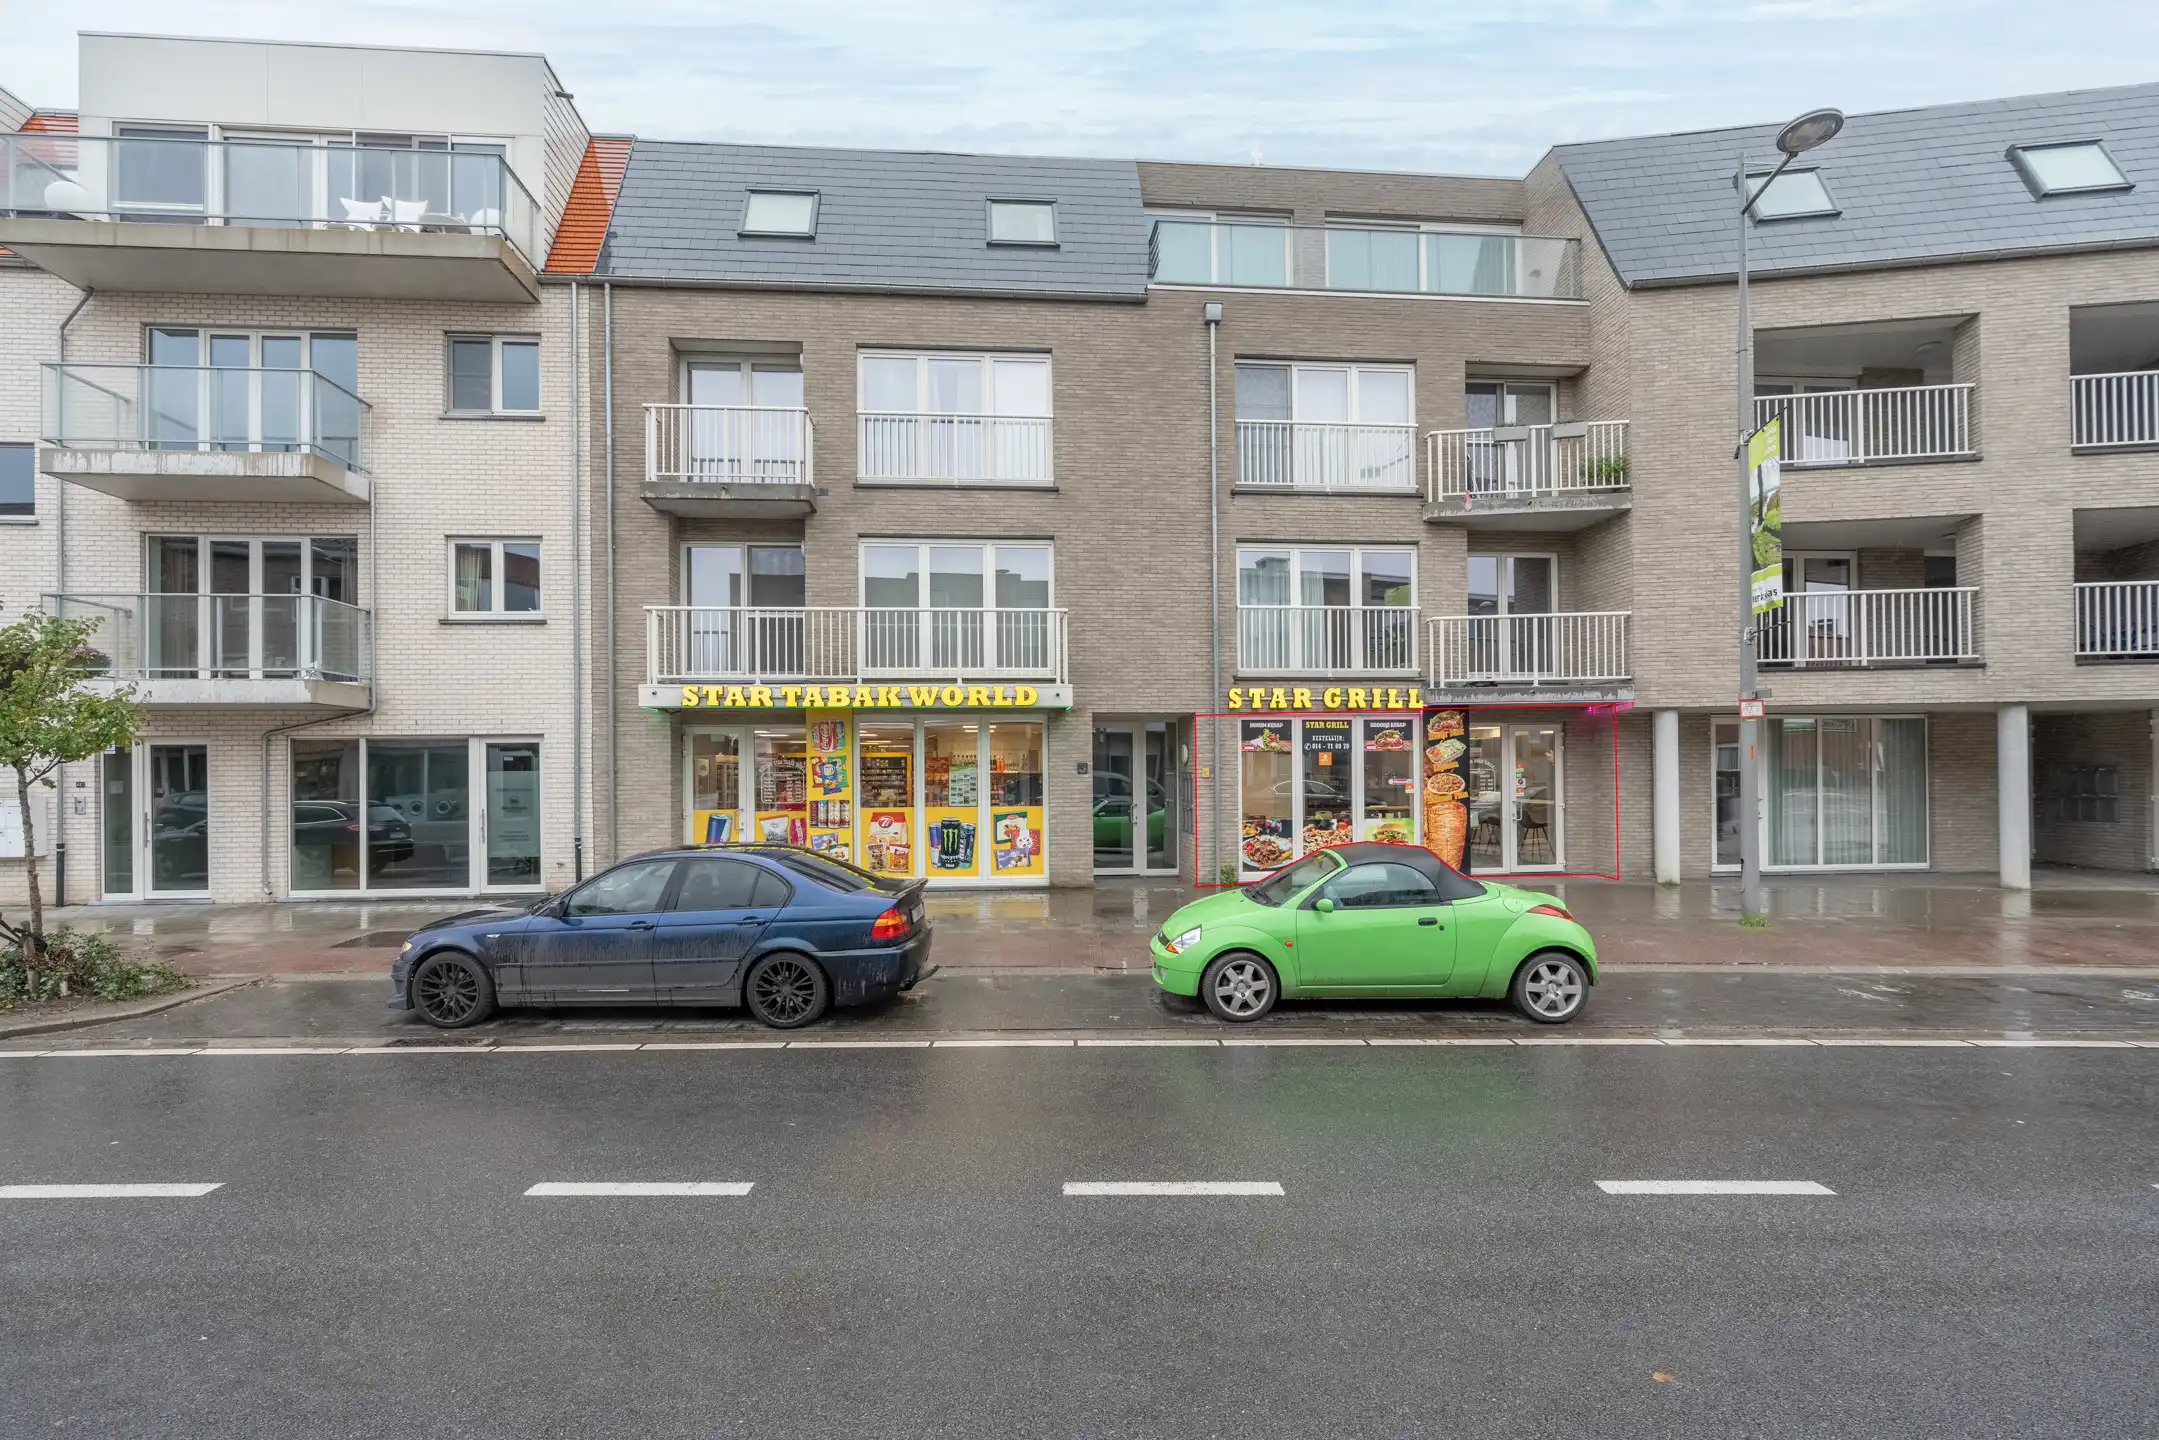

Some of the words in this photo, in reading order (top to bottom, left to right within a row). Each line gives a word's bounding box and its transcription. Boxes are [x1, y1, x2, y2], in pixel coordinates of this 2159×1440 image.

[681, 685, 774, 707] STAR
[781, 685, 902, 707] TABAK
[907, 685, 1038, 707] WORLD
[1228, 687, 1313, 709] STAR
[1323, 687, 1424, 709] GRILL
[1305, 721, 1325, 729] STAR
[1326, 721, 1349, 729] GRILL
